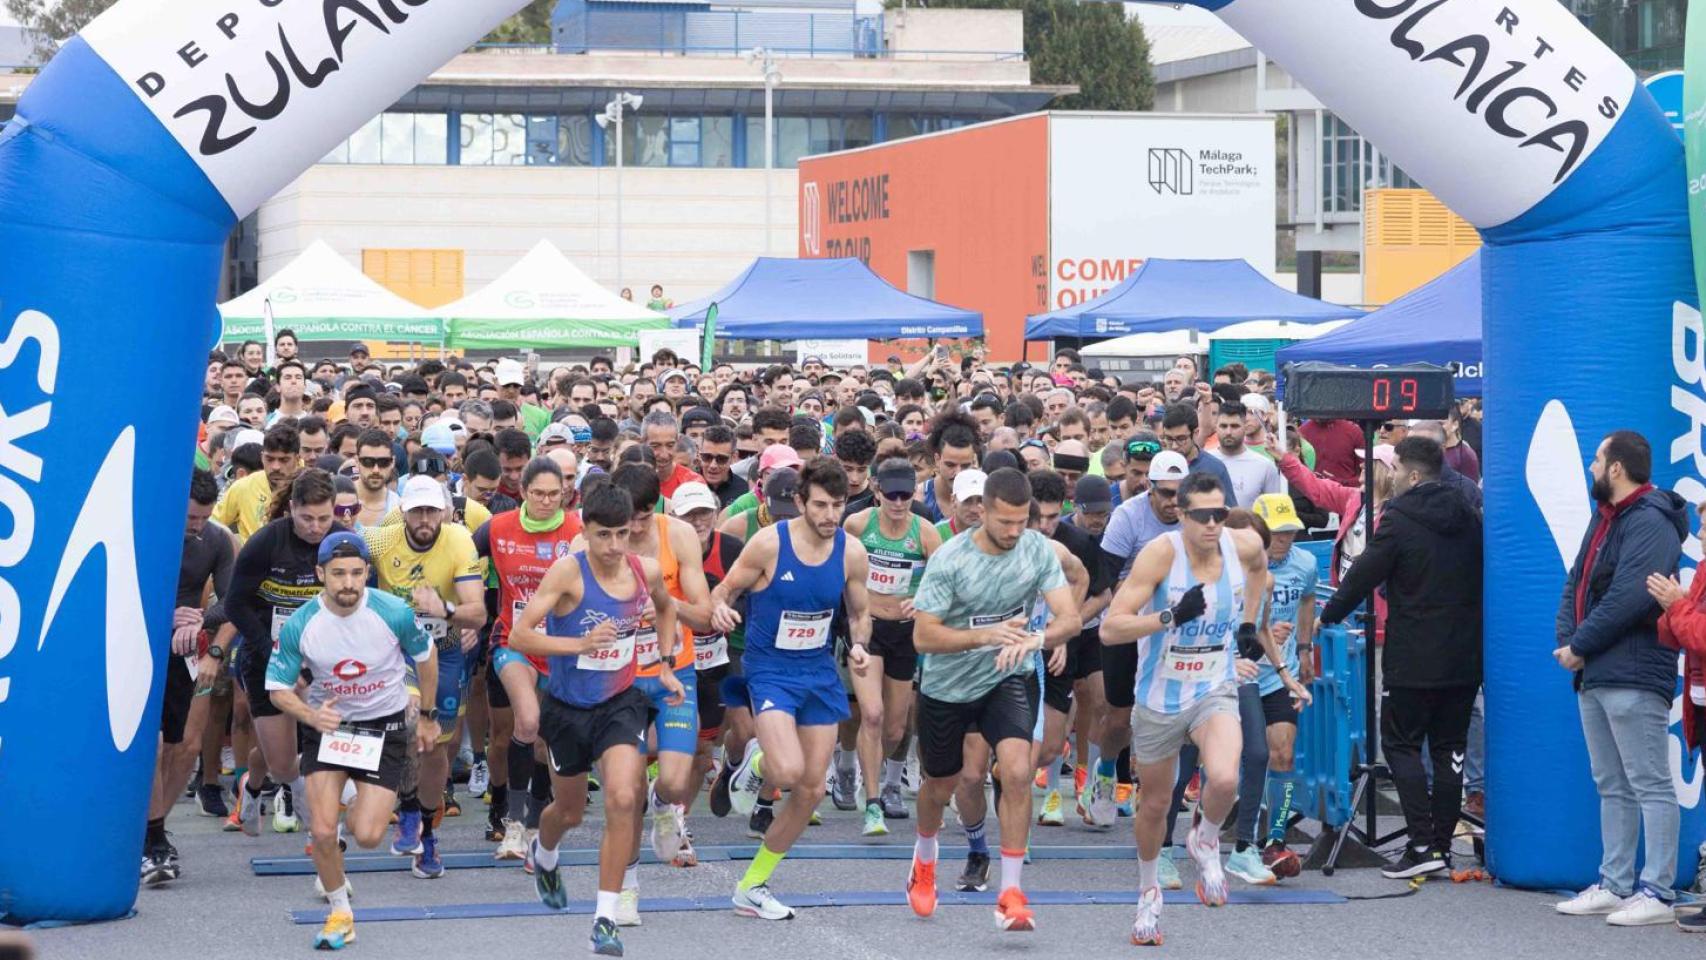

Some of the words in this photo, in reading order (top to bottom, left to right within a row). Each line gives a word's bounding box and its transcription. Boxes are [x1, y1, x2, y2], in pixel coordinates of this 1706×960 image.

[136, 0, 283, 98] DEP
[1354, 0, 1589, 184] LAICA
[1200, 149, 1242, 162] Málaga
[827, 174, 889, 223] WELCOME
[341, 323, 381, 333] CONTRA
[383, 324, 394, 333] EL
[399, 323, 437, 334] CÁNCER
[1372, 379, 1417, 411] 09
[874, 549, 904, 558] ATLETISMO
[871, 572, 895, 584] 801
[787, 627, 816, 638] 729
[636, 642, 658, 654] 37
[1174, 661, 1204, 671] 810
[328, 740, 362, 755] 402
